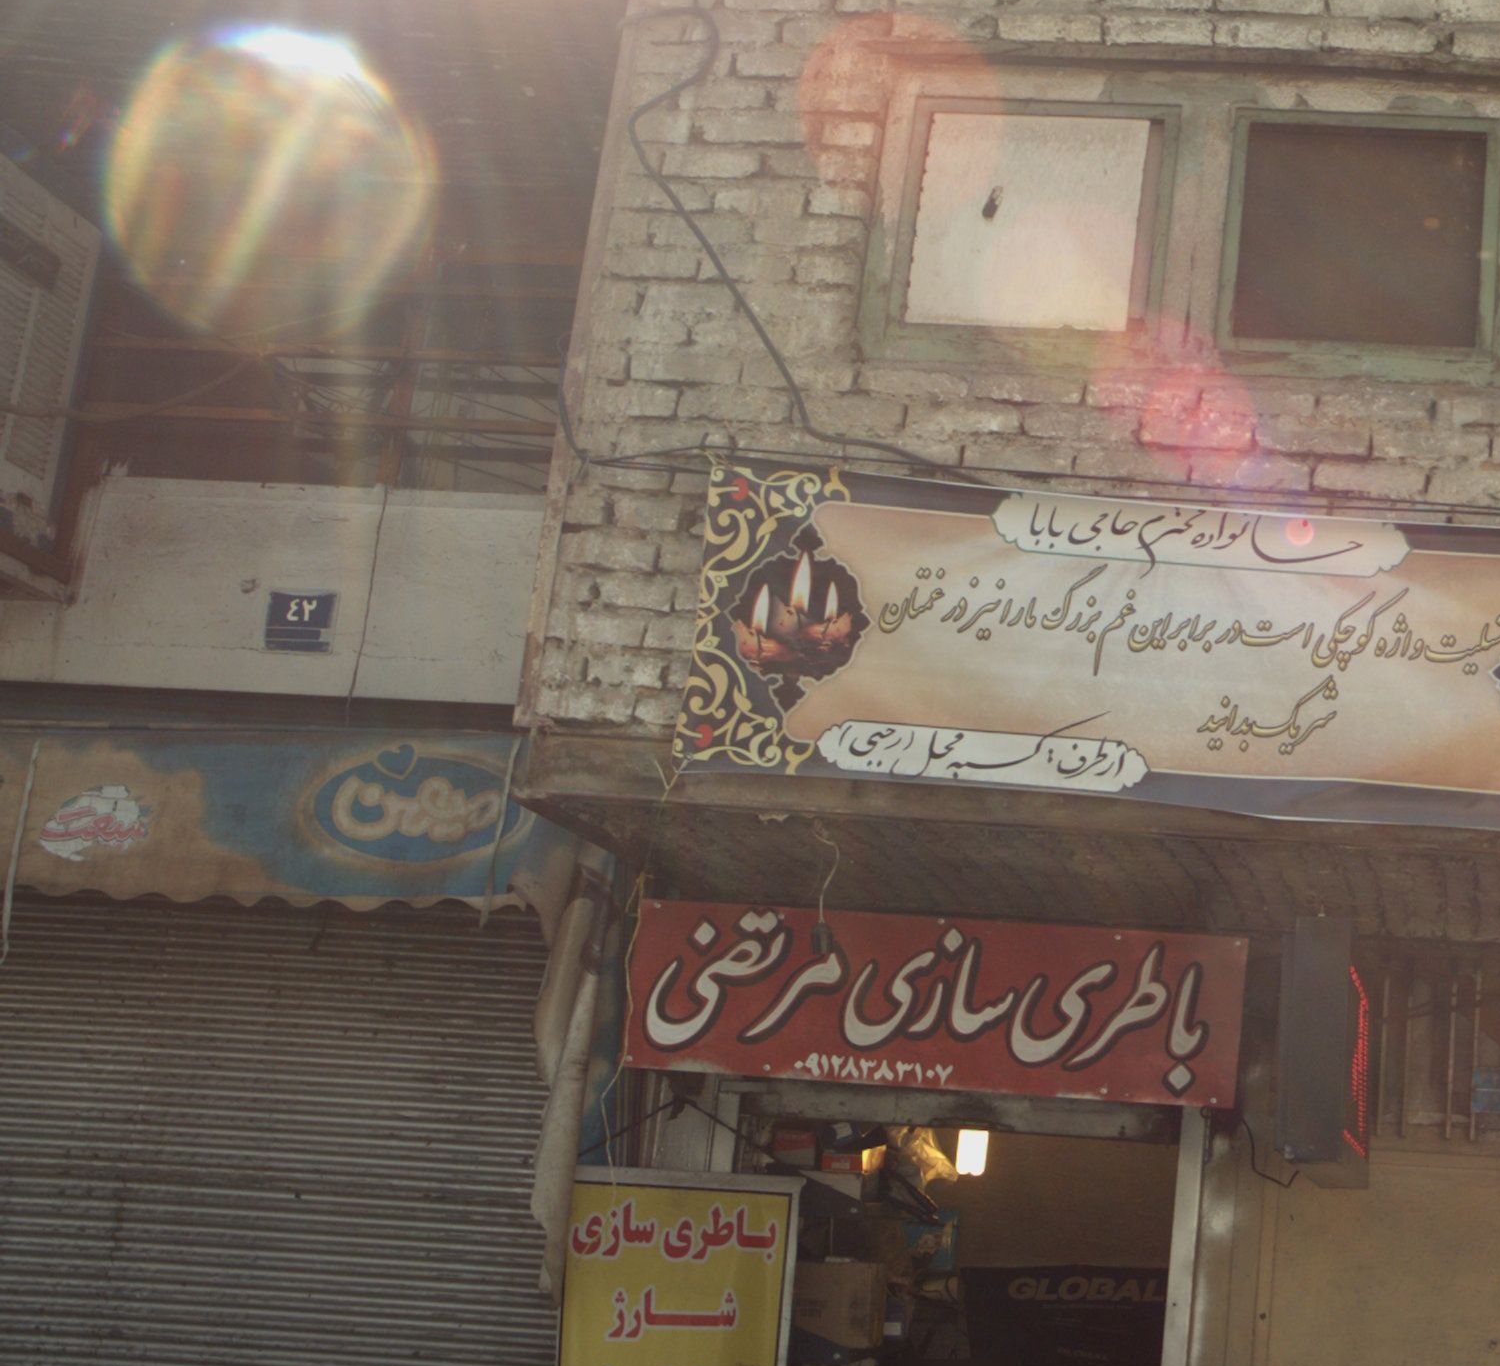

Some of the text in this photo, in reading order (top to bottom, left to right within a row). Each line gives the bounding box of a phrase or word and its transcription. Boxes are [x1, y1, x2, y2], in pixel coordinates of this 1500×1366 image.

[1029, 503, 1061, 550] بابا
[1068, 508, 1139, 552] حاجی
[878, 566, 946, 634] غمتان
[1041, 564, 1108, 644] بزرگ
[1092, 588, 1137, 677] غم
[1215, 620, 1243, 645] در
[1240, 620, 1315, 648] است
[1374, 612, 1425, 661] واژه
[1197, 674, 1339, 755] شریک بدانید
[643, 908, 1208, 1092] باطری سازی مرتضی
[571, 1201, 779, 1262] باطری سازی
[606, 1288, 739, 1339] شارژ
[1007, 1275, 1167, 1303] GLOBAL
